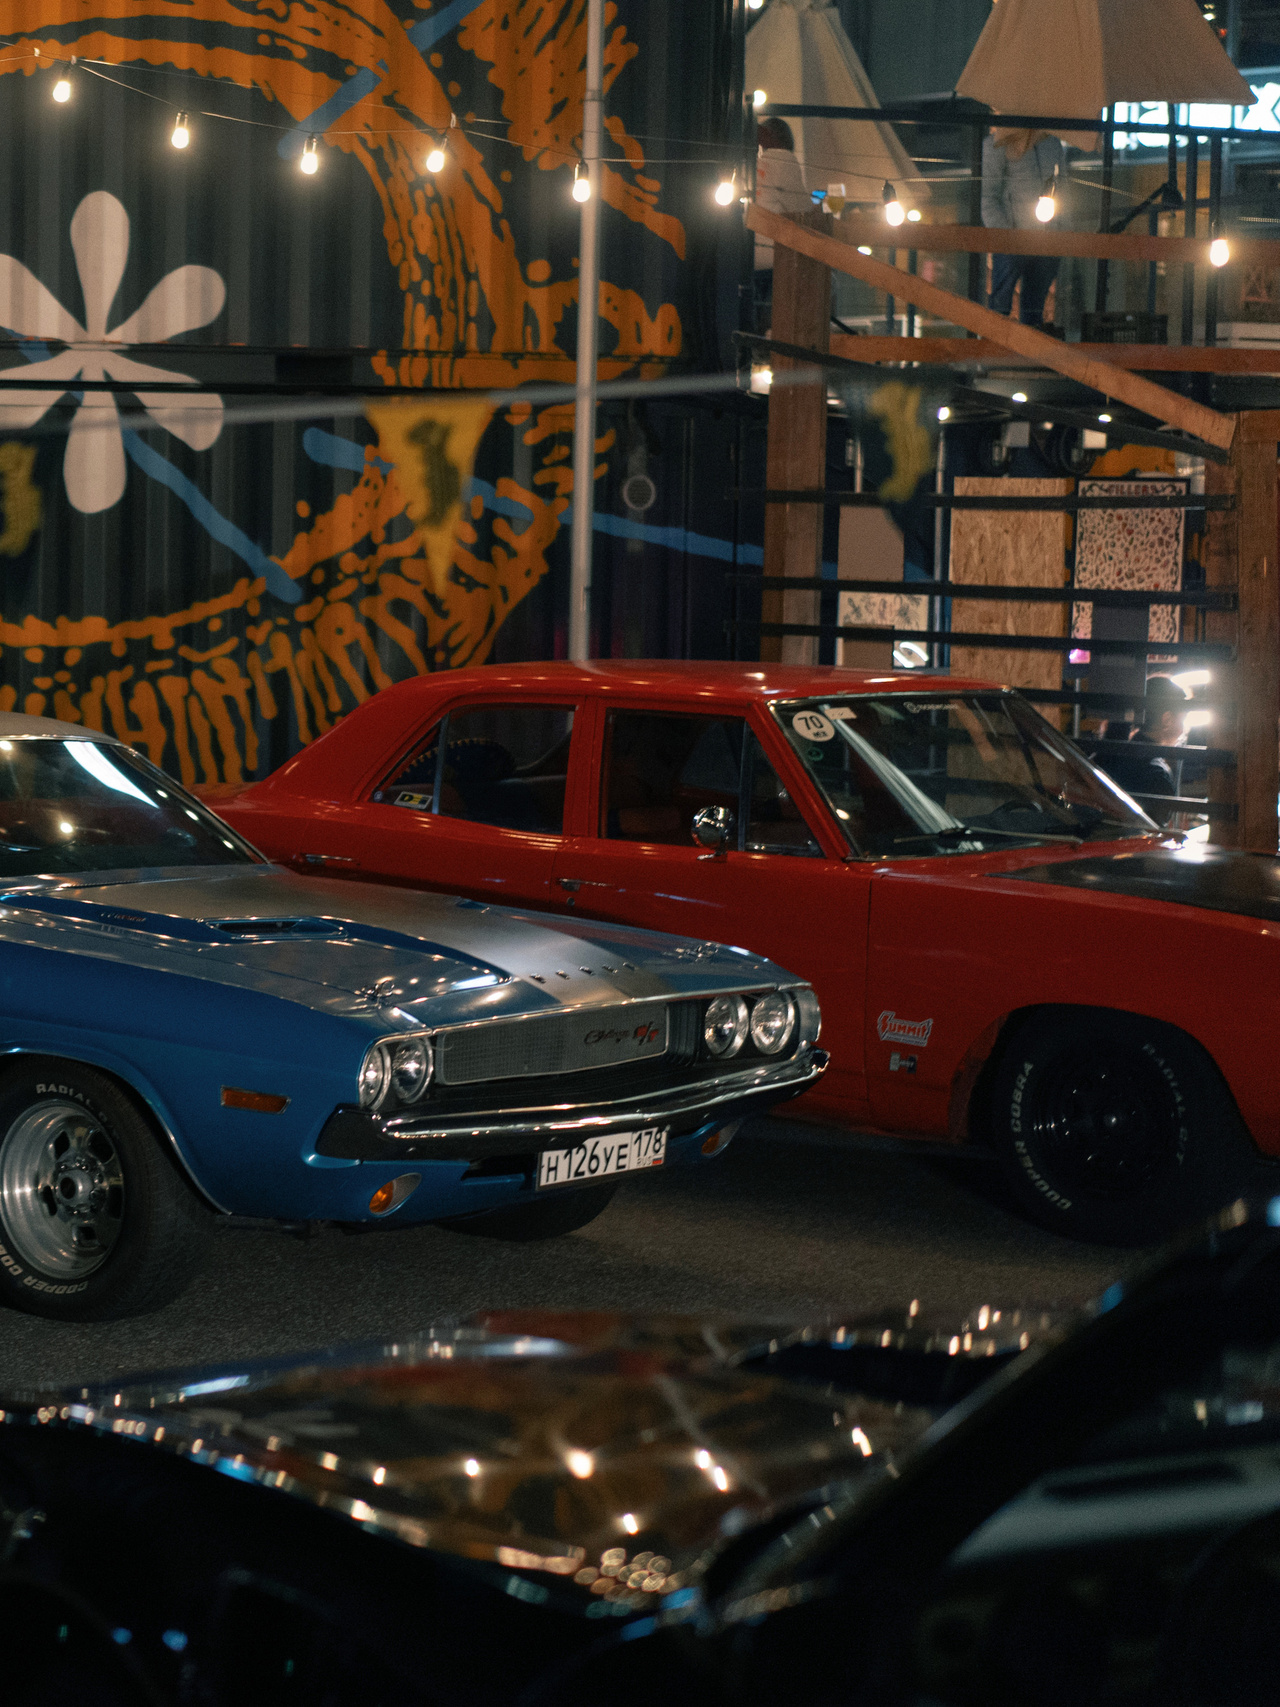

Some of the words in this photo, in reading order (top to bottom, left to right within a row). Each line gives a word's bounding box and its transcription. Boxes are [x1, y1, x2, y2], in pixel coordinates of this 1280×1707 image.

[797, 715, 824, 731] 70
[880, 1013, 930, 1040] SUMMIT
[35, 1083, 94, 1110] RADIAL
[633, 1131, 663, 1158] 178
[23, 1275, 89, 1294] COOPER
